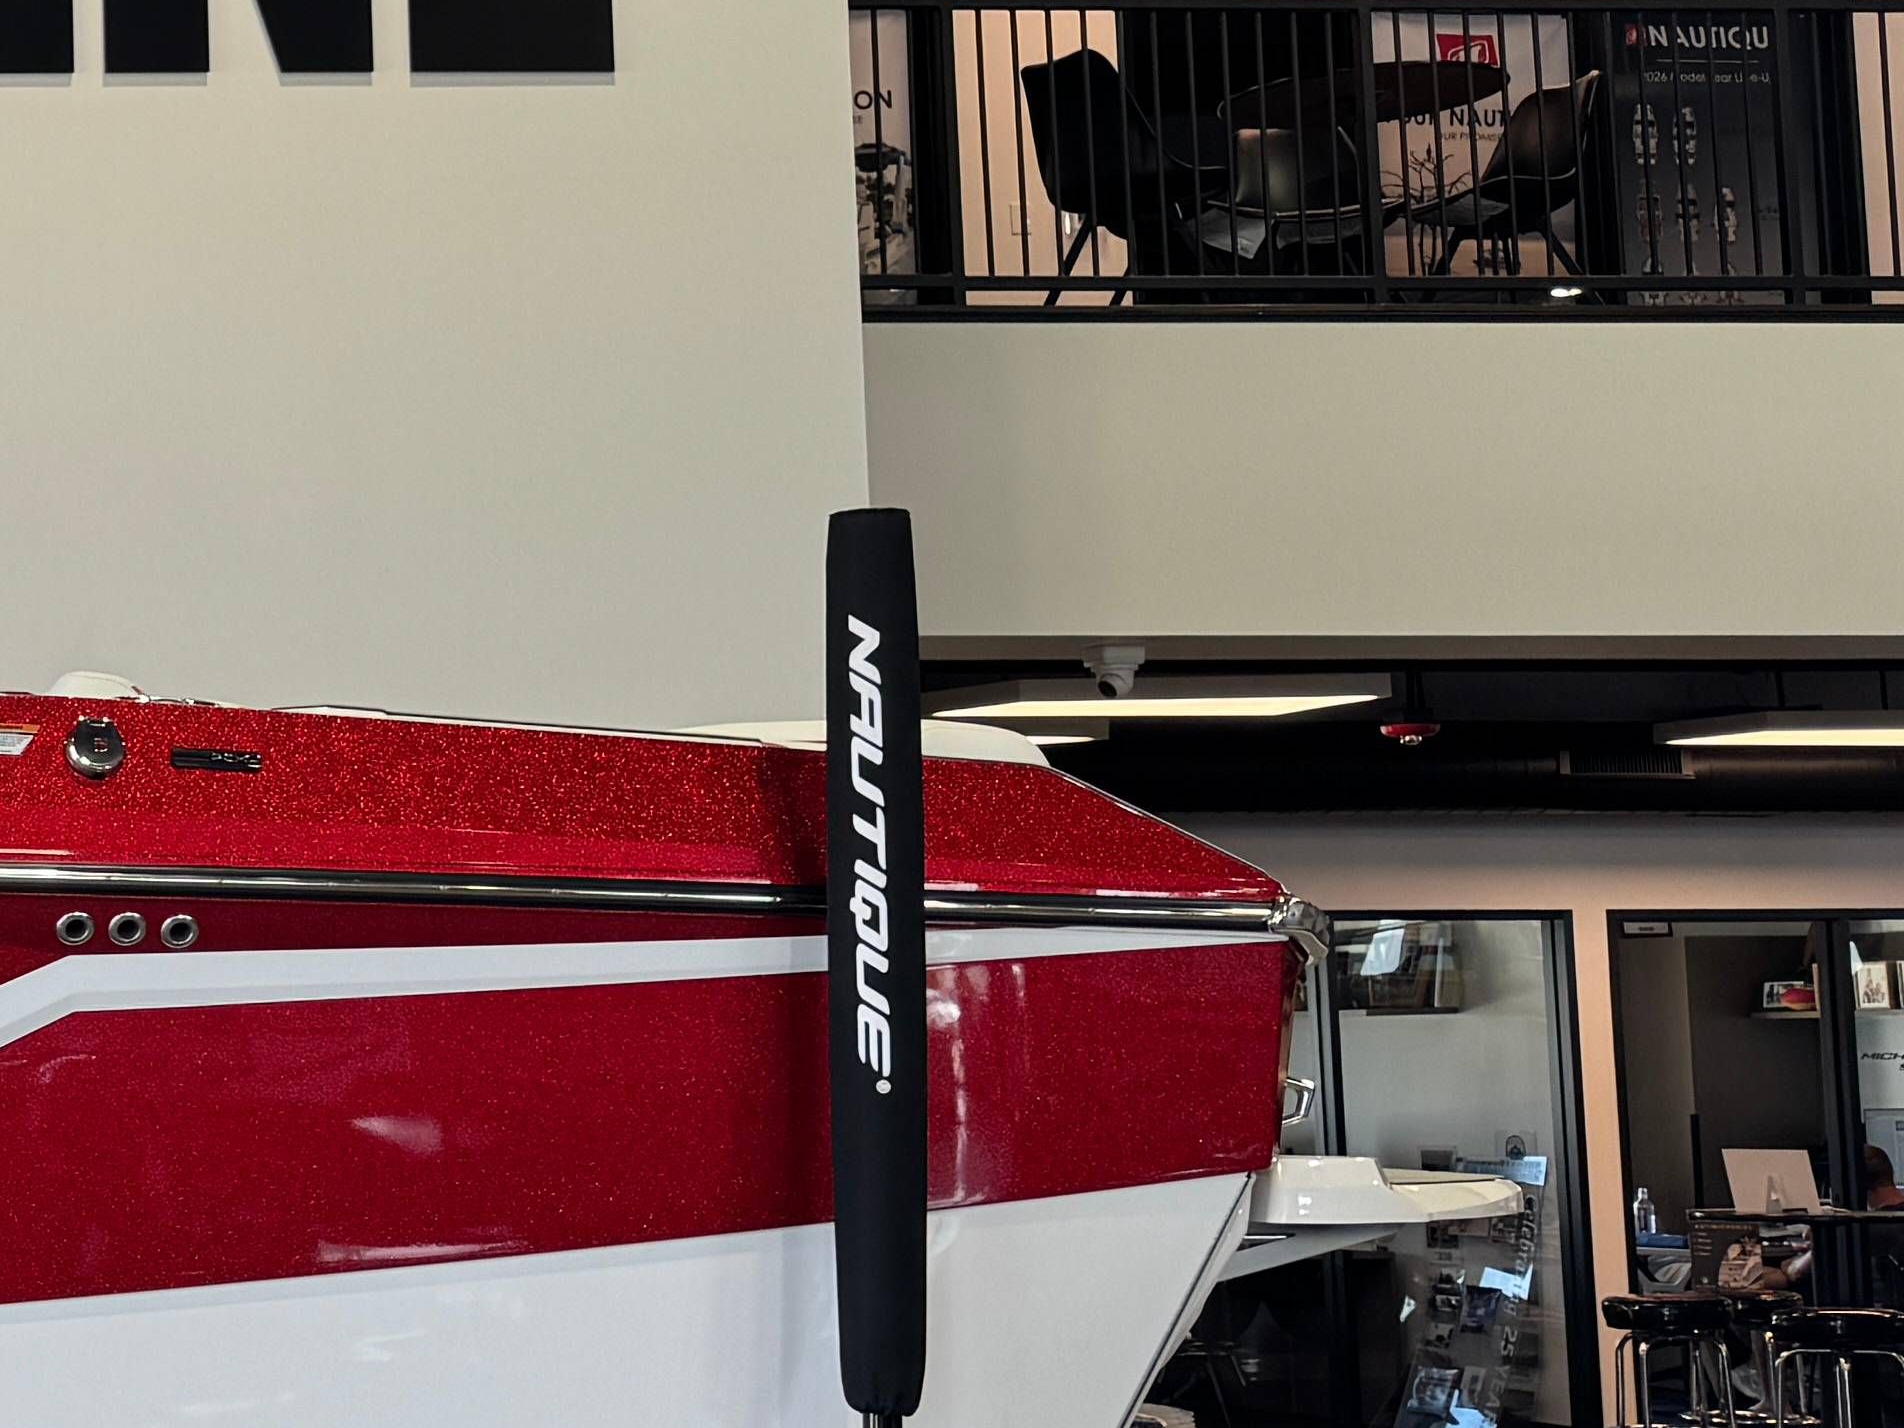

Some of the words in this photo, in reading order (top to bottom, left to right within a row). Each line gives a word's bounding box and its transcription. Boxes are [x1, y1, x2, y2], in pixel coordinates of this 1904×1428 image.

[1648, 25, 1769, 50] NAUTIQU
[1644, 72, 1667, 83] 026
[847, 614, 892, 1078] NAUTIQUE
